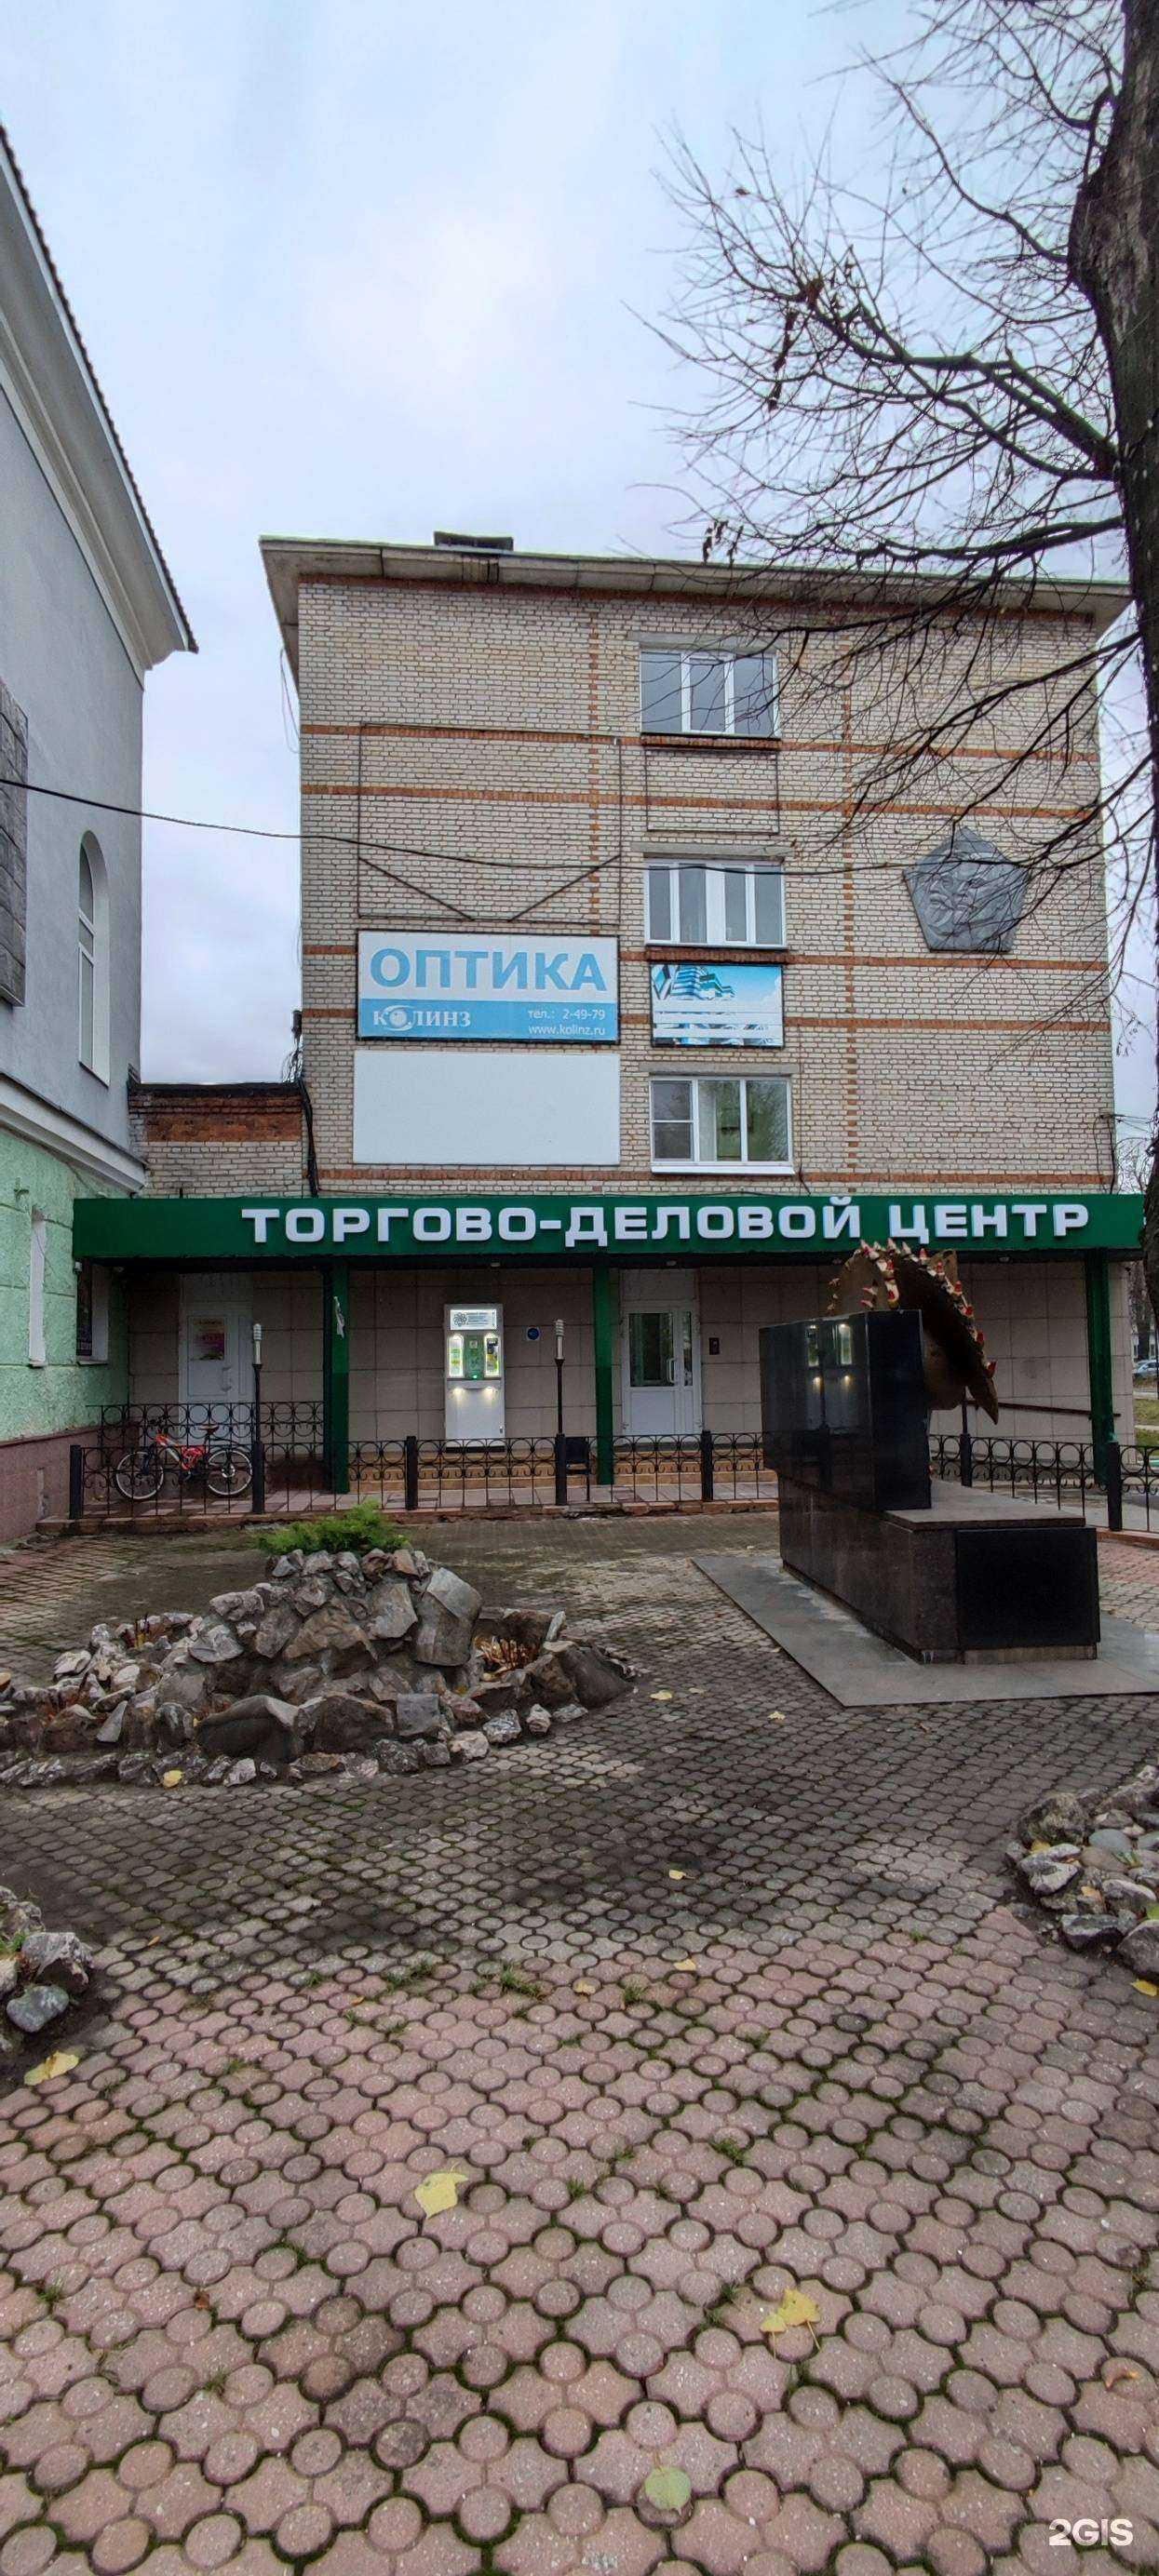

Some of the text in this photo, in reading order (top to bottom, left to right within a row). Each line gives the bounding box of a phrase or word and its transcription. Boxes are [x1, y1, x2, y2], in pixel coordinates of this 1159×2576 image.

[370, 947, 607, 991] ОПТИКА
[562, 1009, 605, 1020] 2-49-79
[529, 1024, 605, 1036] www.kolinz.ru
[241, 1196, 1089, 1247] ТОРГОВО-ДЕЛОВОЙ ЦЕНТР
